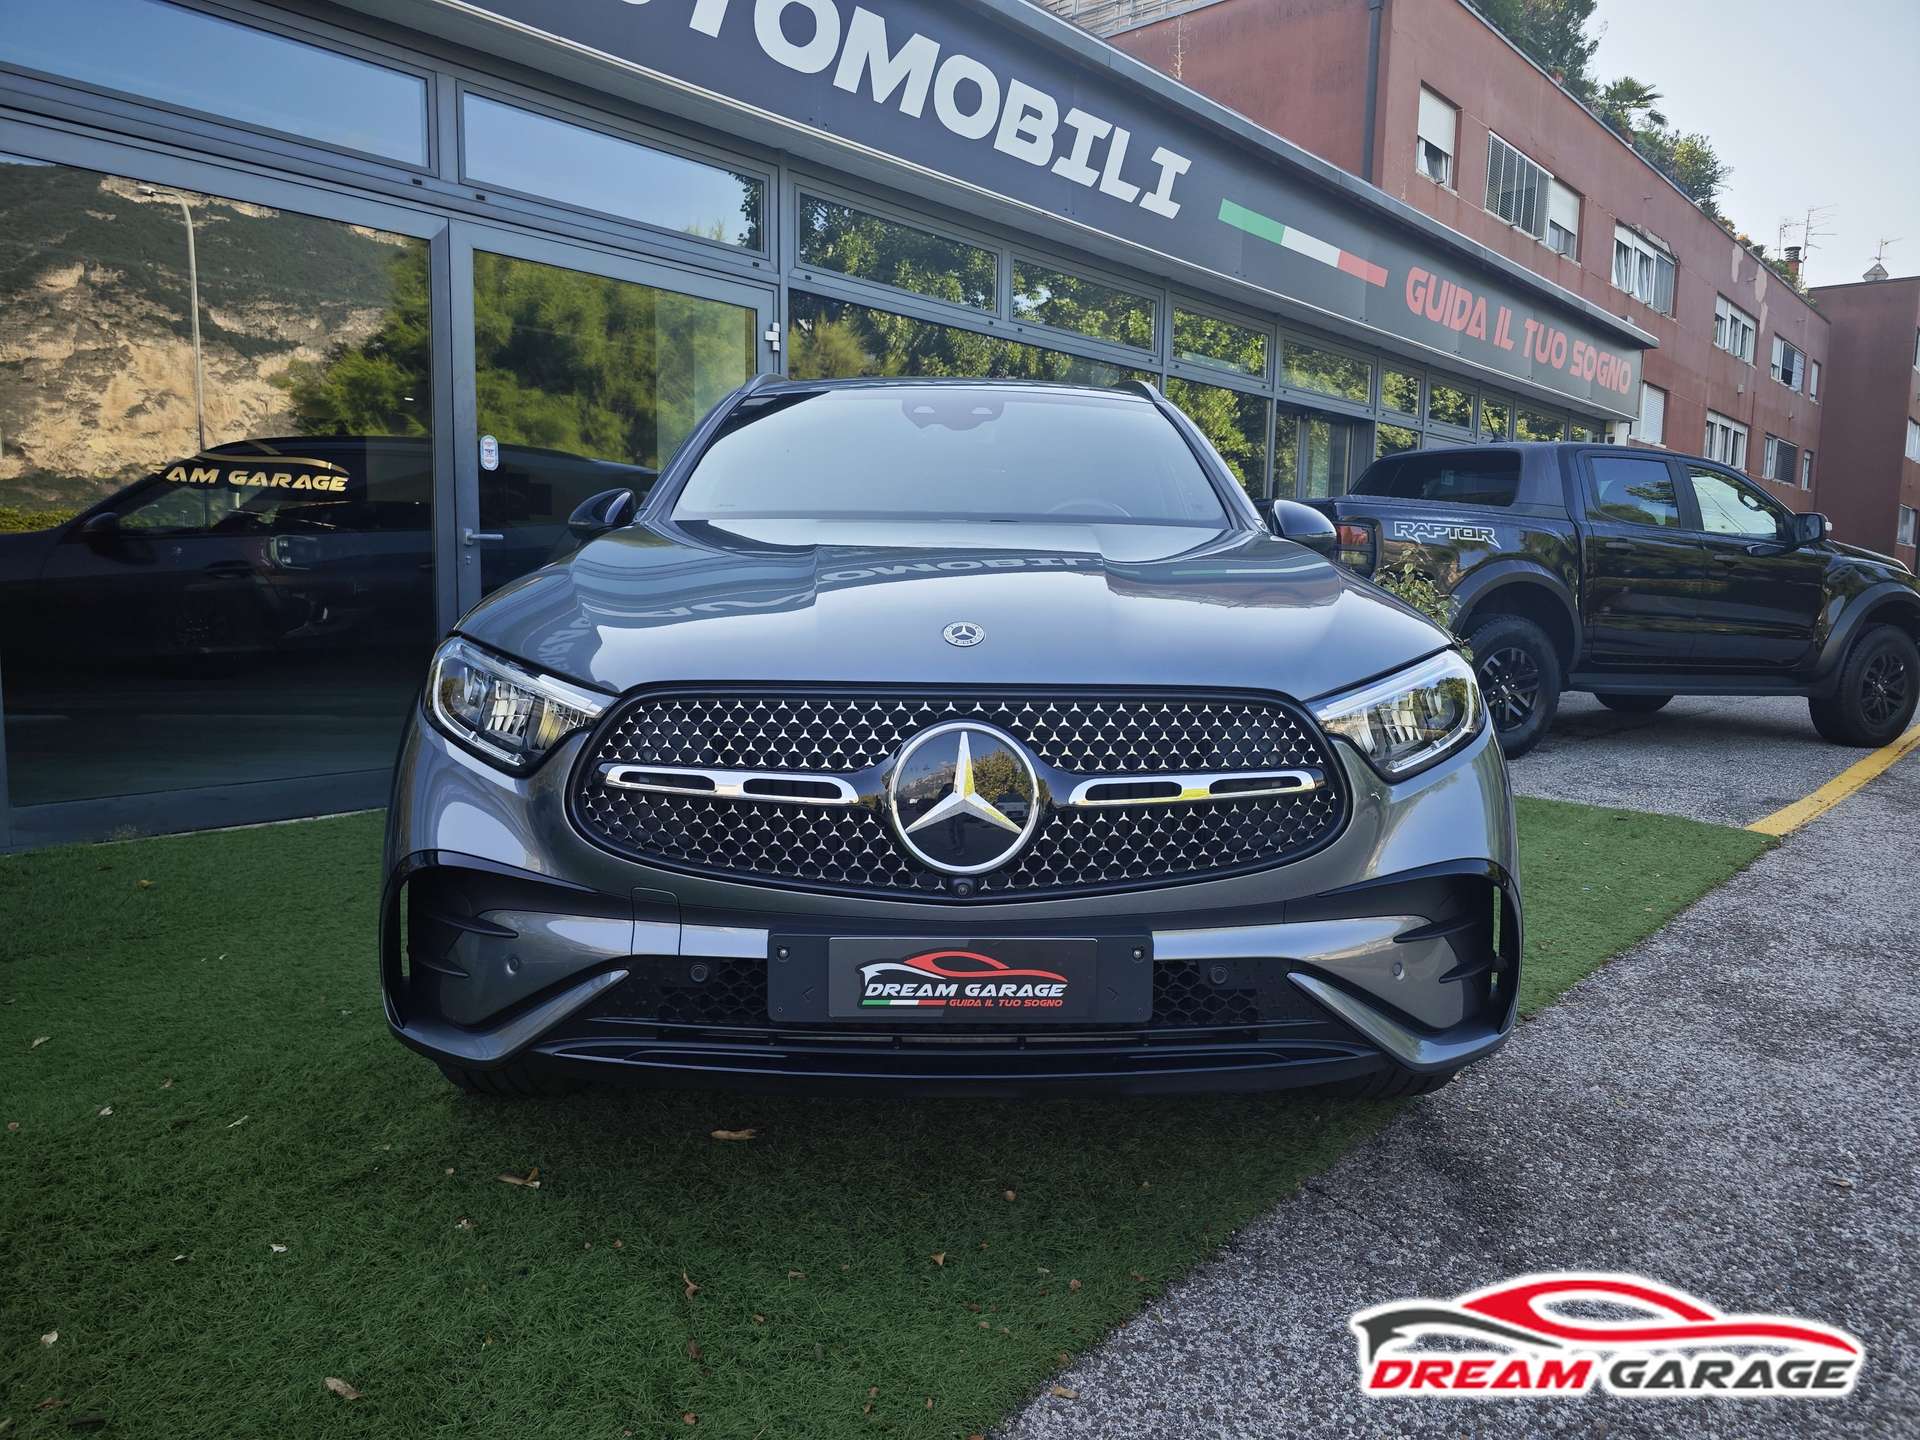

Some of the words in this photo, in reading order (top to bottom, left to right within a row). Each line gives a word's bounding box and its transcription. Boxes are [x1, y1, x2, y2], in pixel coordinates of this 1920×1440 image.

[621, 0, 1192, 220] OMOBILI
[1405, 266, 1487, 341] GUIDA
[1493, 305, 1515, 352] IL
[1523, 318, 1568, 370] TUO
[1570, 340, 1632, 395] SOGNO
[227, 469, 350, 492] GARAGE
[1394, 521, 1502, 550] RAPTOR
[864, 983, 960, 997] DREAM
[964, 983, 1068, 997] GARAGE
[949, 999, 982, 1007] GUIDA
[984, 999, 994, 1007] IL
[999, 999, 1022, 1007] TUO
[1024, 999, 1064, 1007] SOGNO
